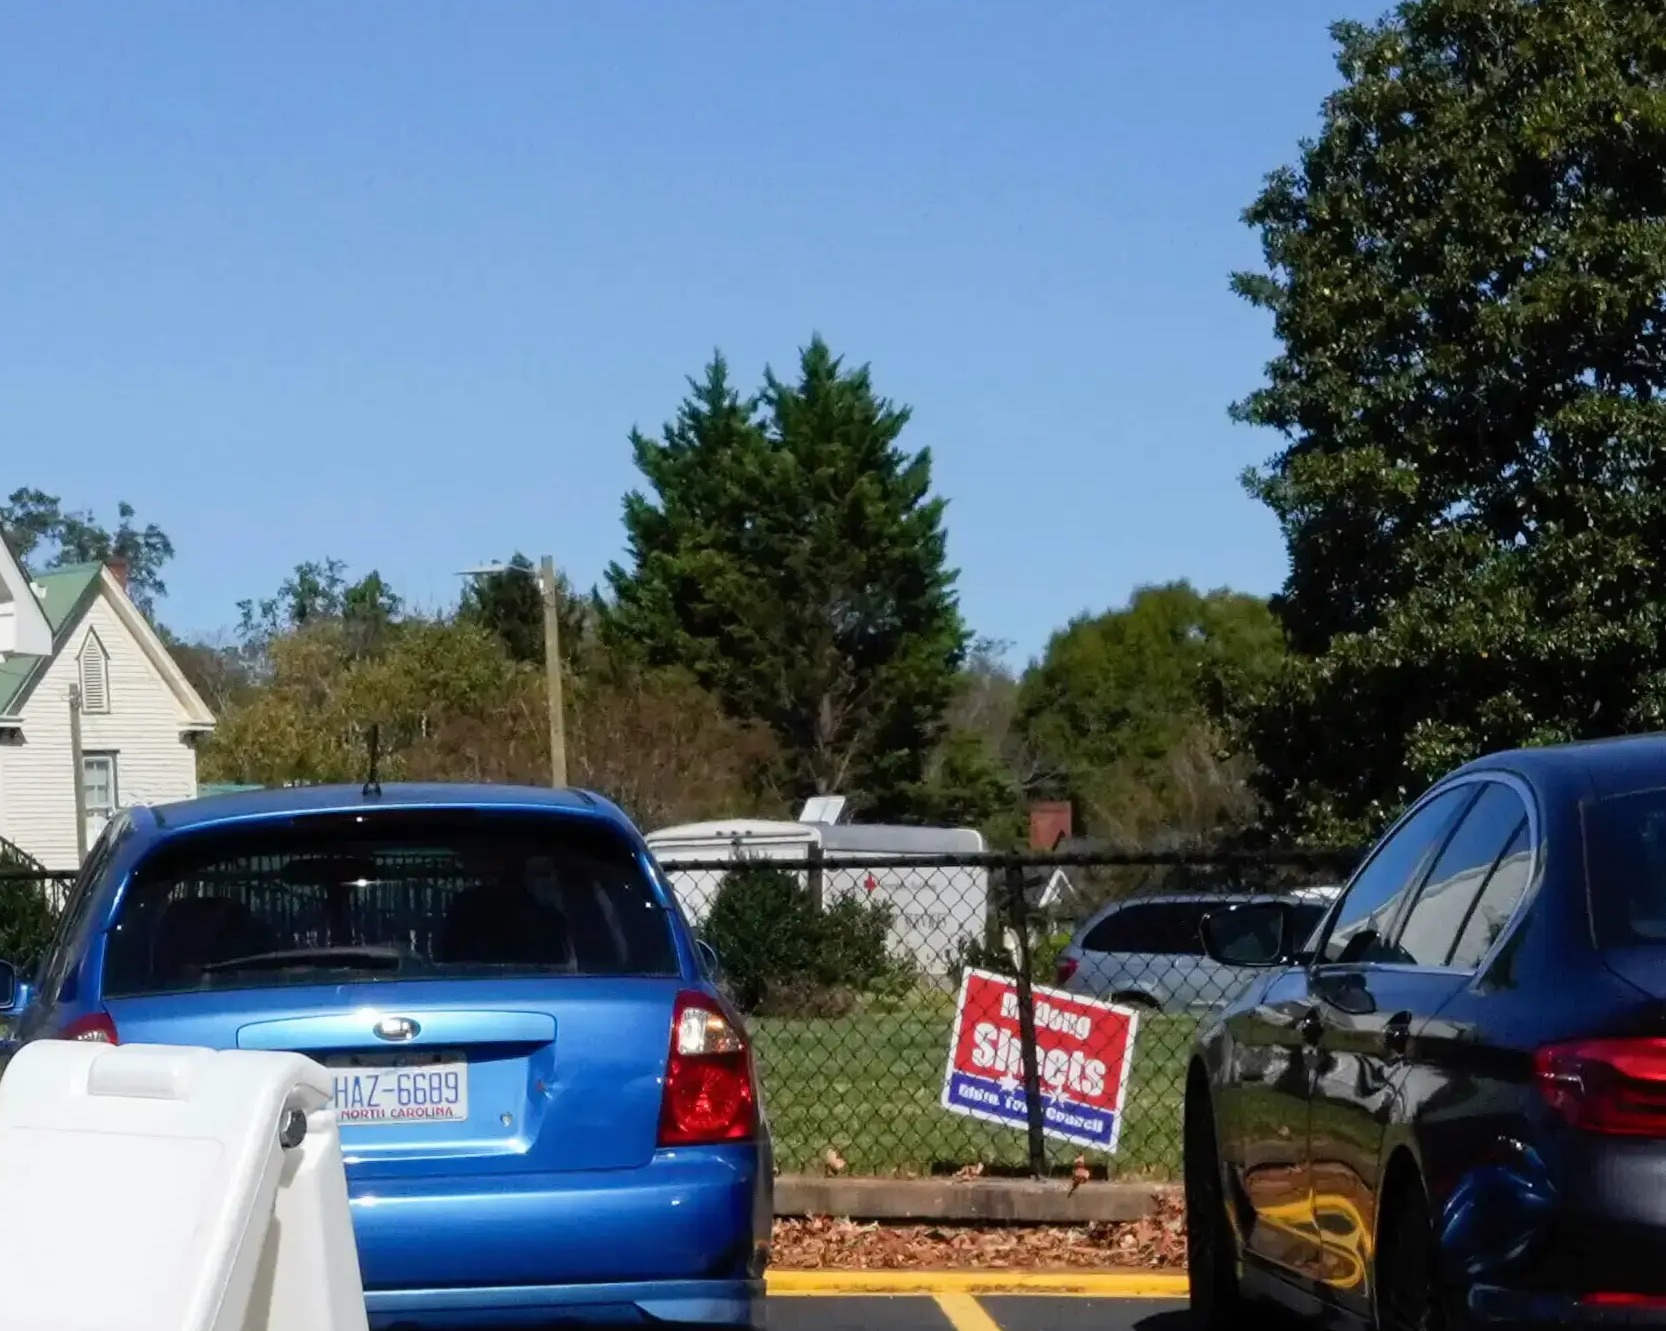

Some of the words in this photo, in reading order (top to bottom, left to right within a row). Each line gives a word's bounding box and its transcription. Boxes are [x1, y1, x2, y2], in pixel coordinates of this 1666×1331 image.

[972, 1022, 1106, 1096] Shets
[334, 1072, 458, 1108] HAZ-6689
[341, 1109, 385, 1120] NORTH
[390, 1107, 453, 1118] CAROLINA
